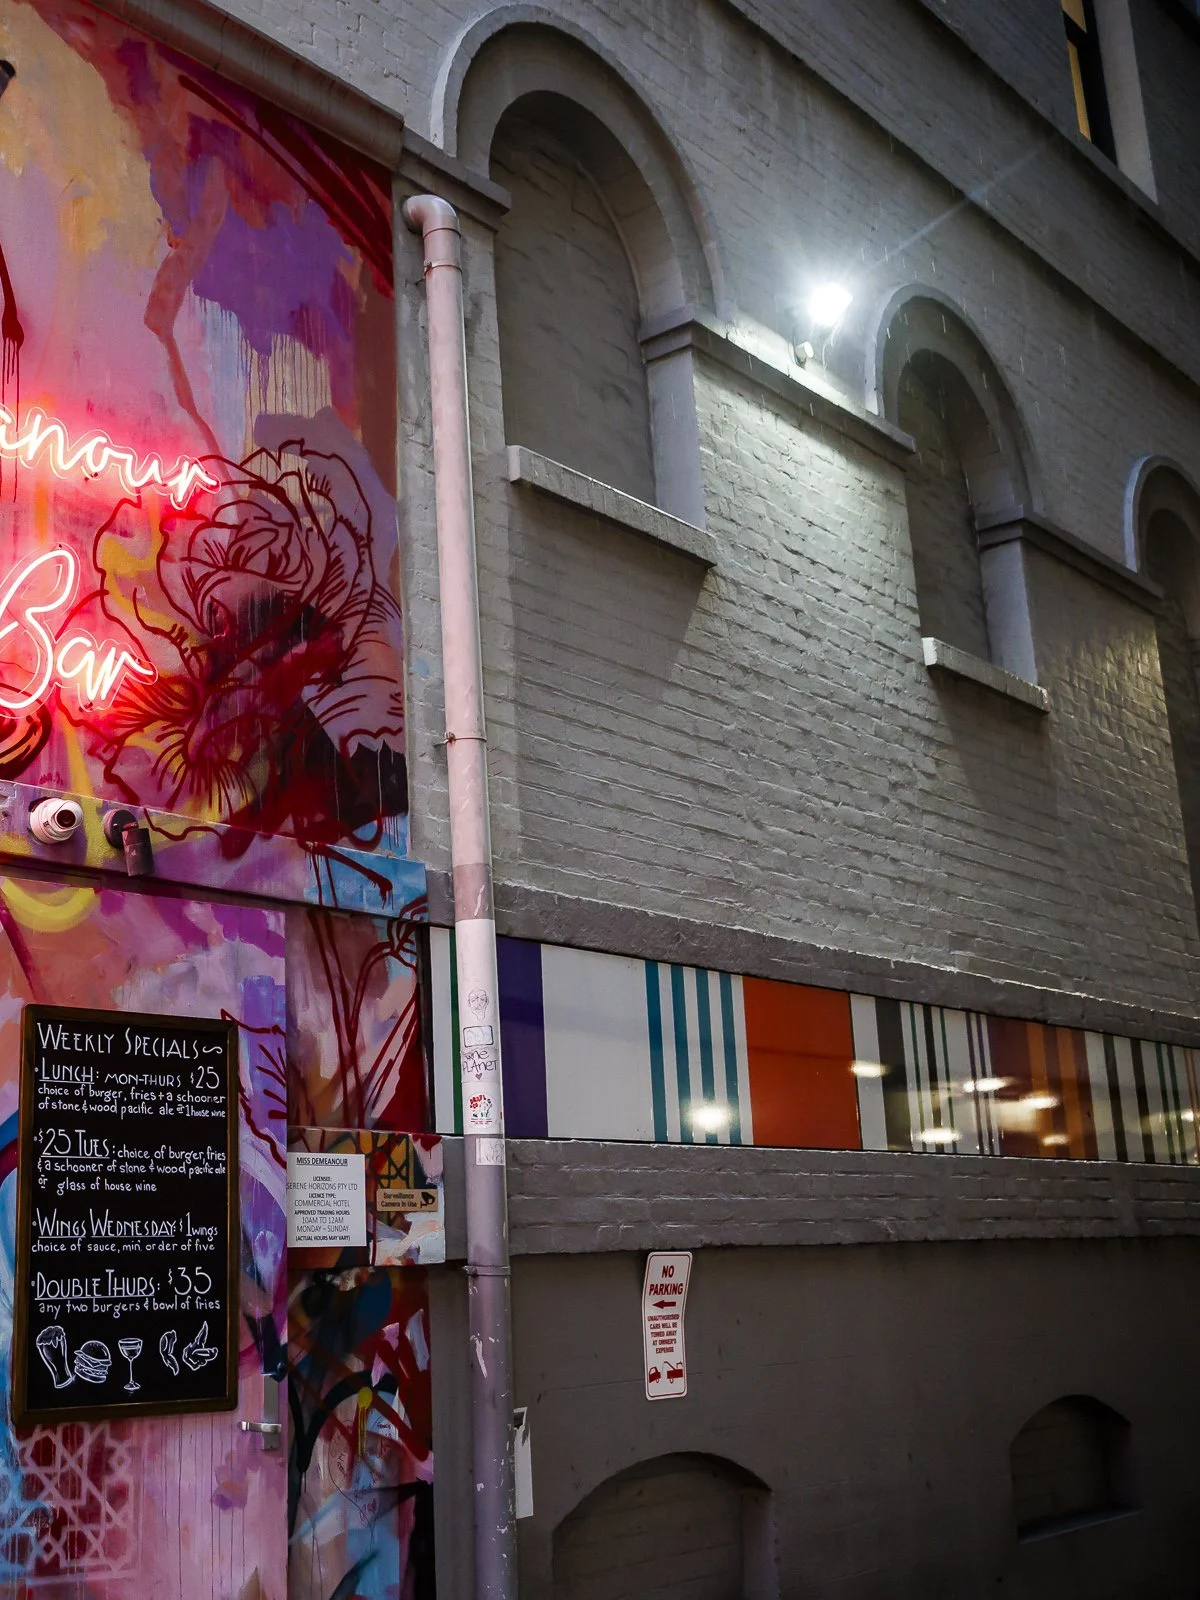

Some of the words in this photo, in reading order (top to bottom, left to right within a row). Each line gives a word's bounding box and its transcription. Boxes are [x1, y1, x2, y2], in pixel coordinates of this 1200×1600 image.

[37, 1023, 114, 1053] WEEKLY
[125, 1028, 198, 1059] SPECIALS
[42, 1057, 100, 1081] LUNCH:
[105, 1074, 181, 1088] MON-THURS
[190, 1066, 219, 1089] $25
[38, 1086, 69, 1095] choice
[75, 1084, 85, 1096] of
[89, 1085, 126, 1102] burger,
[177, 1091, 226, 1104] schooner
[39, 1097, 50, 1110] of
[51, 1100, 80, 1112] stone
[89, 1100, 118, 1114] wood
[121, 1103, 153, 1120] pacific
[159, 1103, 174, 1116] ale
[38, 1128, 71, 1156] $25
[75, 1129, 115, 1157] TUES:
[117, 1146, 150, 1159] choice
[154, 1145, 166, 1159] of
[206, 1147, 226, 1161] fries
[45, 1159, 51, 1171] a
[54, 1159, 103, 1172] schooner
[107, 1159, 117, 1173] of
[120, 1162, 146, 1174] stone
[156, 1162, 186, 1175] wood
[189, 1163, 214, 1179] pacific
[214, 1163, 226, 1175] ale
[296, 1157, 310, 1165] MISS
[312, 1158, 348, 1166] DEMEANOUR
[57, 1178, 86, 1196] glass
[90, 1177, 101, 1191] of
[105, 1178, 132, 1191] house
[135, 1180, 157, 1191] wine
[287, 1182, 307, 1190] SERENE
[309, 1182, 336, 1190] HORIZONS
[36, 1208, 86, 1236] WINGS
[32, 1240, 67, 1252] choice
[70, 1238, 83, 1252] of
[87, 1243, 120, 1254] sauce,
[145, 1240, 178, 1251] order
[181, 1239, 193, 1251] of
[195, 1238, 215, 1251] five
[662, 1265, 674, 1278] NO
[37, 1271, 101, 1298] DOUBLE
[168, 1267, 212, 1295] $35
[649, 1283, 683, 1296] PARKING
[39, 1303, 61, 1320] any
[66, 1300, 88, 1313] two
[93, 1300, 140, 1319] burgers
[153, 1295, 177, 1311] bowl
[181, 1296, 192, 1310] of
[195, 1295, 220, 1310] fries
